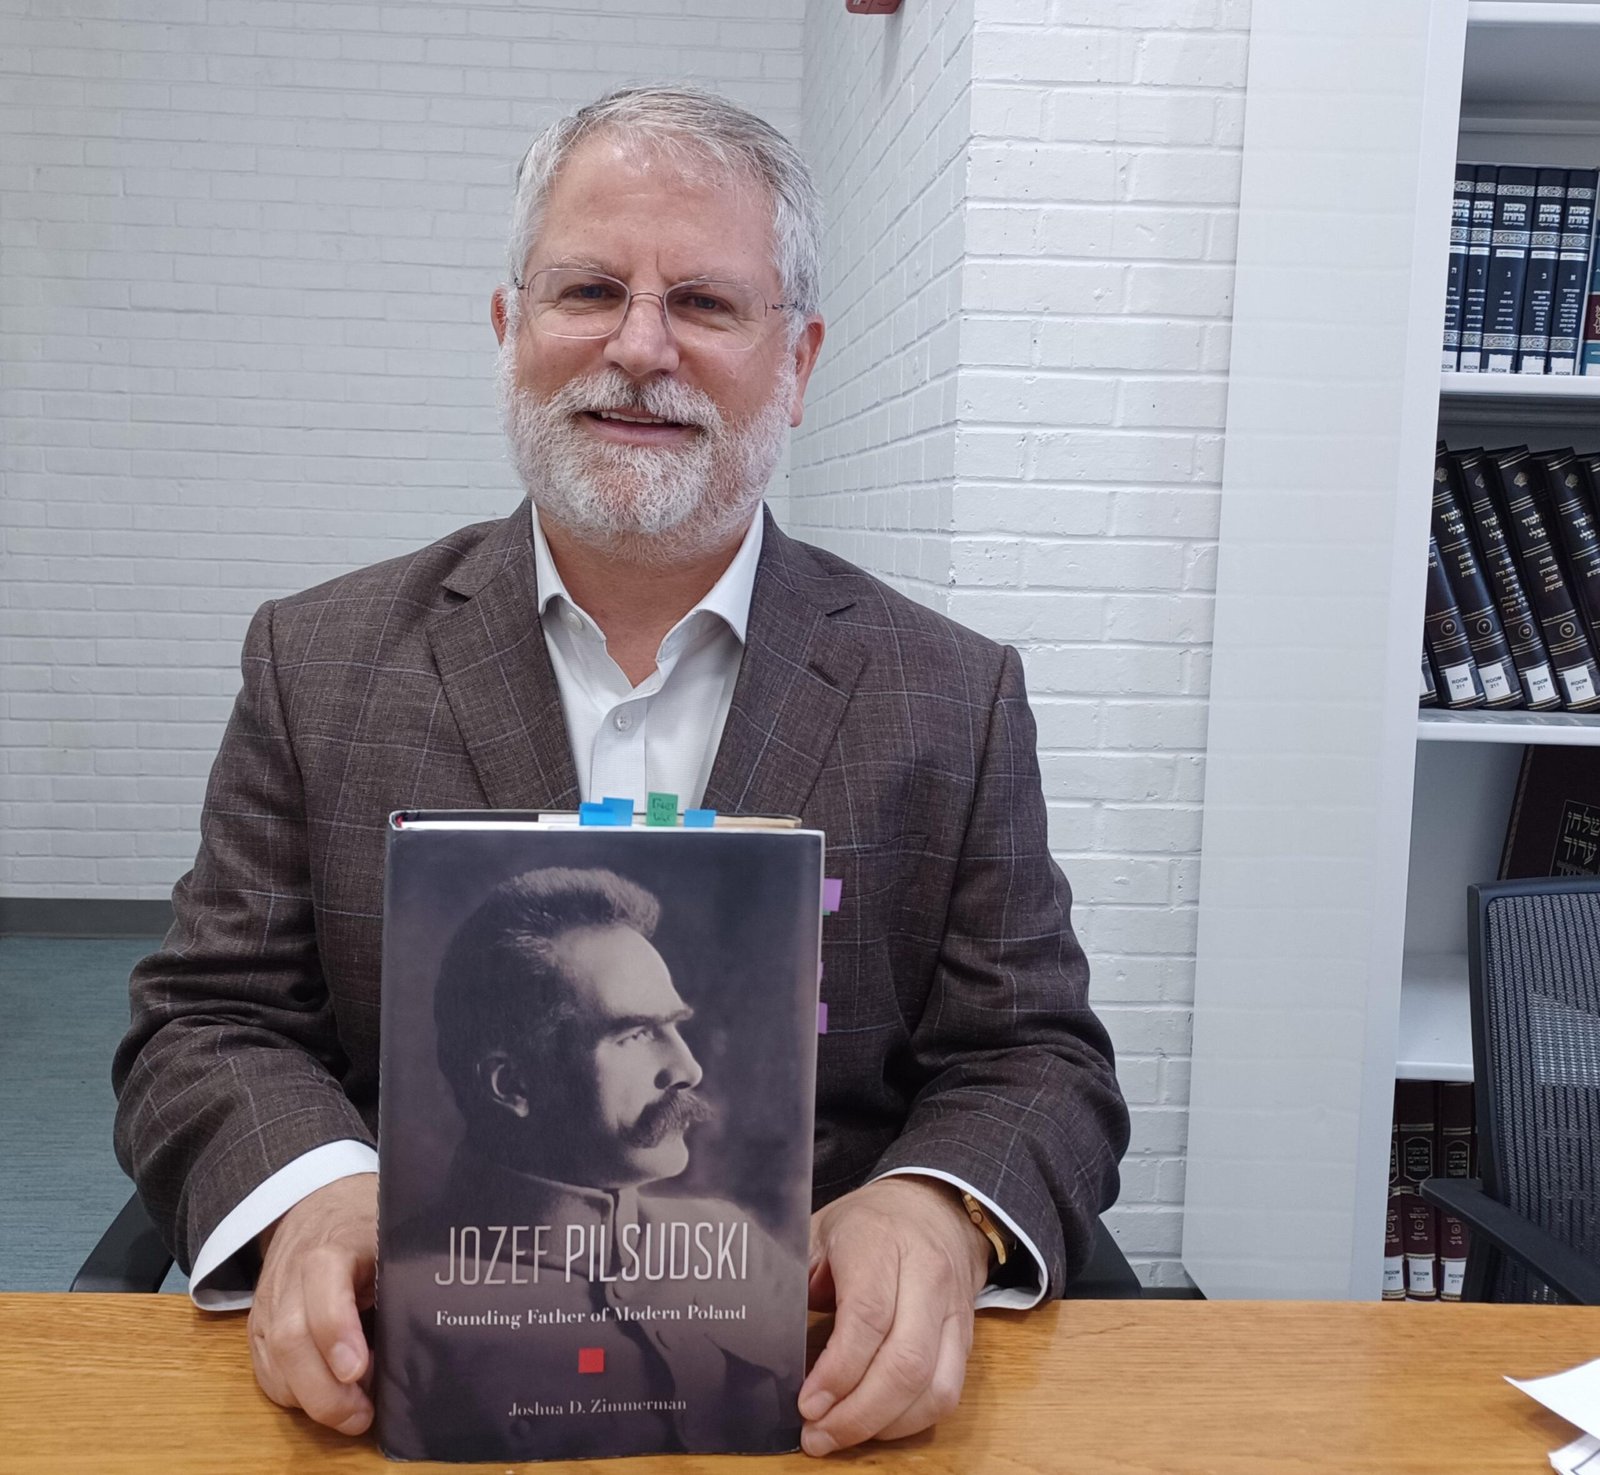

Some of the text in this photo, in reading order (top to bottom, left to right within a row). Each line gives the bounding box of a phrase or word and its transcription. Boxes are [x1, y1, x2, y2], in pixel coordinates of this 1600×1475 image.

[1451, 676, 1469, 685] ROOM
[1485, 675, 1502, 685] ROOM
[1532, 677, 1549, 687] ROOM
[1570, 677, 1588, 687] ROOM
[434, 1221, 748, 1286] JOZEF PILSUDSKI
[436, 1304, 746, 1330] Founding Father of Modern Poland
[508, 1398, 687, 1417] Joshua D. Zimmerman
